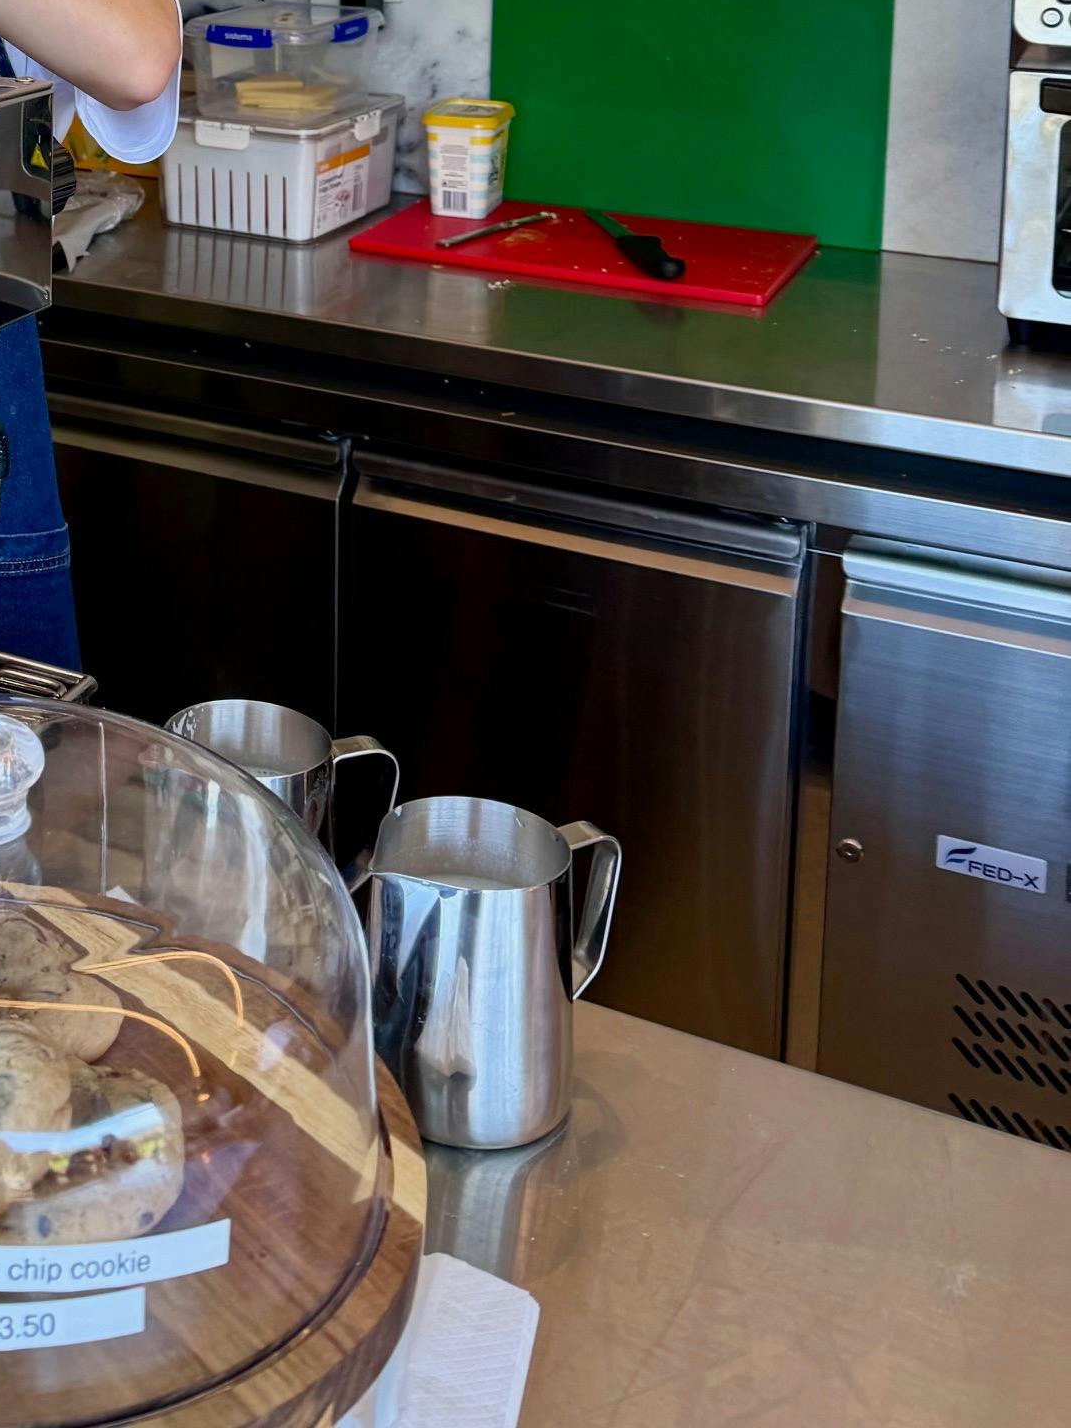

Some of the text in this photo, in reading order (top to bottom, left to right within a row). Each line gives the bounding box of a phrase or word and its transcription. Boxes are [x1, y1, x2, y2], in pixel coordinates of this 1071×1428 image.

[969, 860, 1039, 890] FED-X
[7, 1257, 63, 1284] chip
[70, 1251, 151, 1281] cookie
